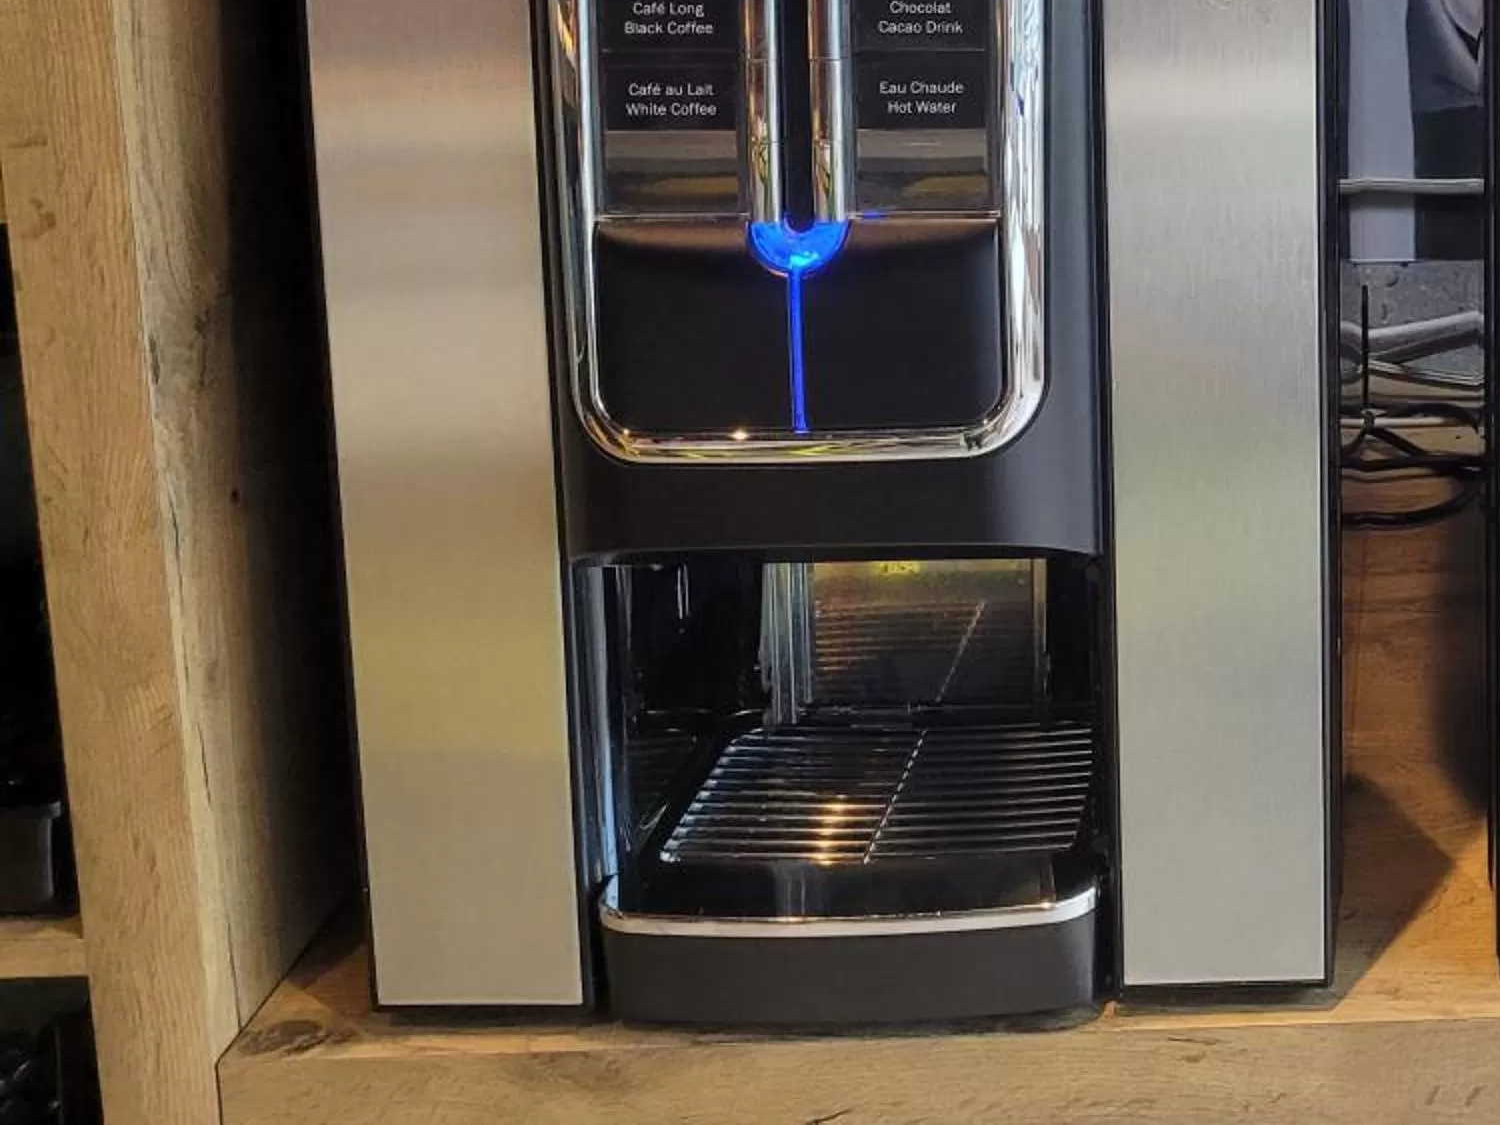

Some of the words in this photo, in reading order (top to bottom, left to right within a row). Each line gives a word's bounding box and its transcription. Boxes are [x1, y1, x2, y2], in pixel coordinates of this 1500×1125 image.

[633, 2, 666, 14] Café
[670, 2, 704, 18] Long
[890, 1, 951, 13] Chocolat
[625, 21, 663, 34] Black
[666, 21, 714, 34] Coffee
[879, 21, 923, 33] Cacao
[927, 20, 963, 33] Drink
[629, 83, 663, 96] Café
[666, 86, 684, 96] au
[688, 83, 713, 96] Lait
[880, 82, 907, 94] Eau
[911, 81, 964, 94] Chaude
[626, 103, 666, 116] White
[671, 103, 716, 116] Coffee
[888, 101, 911, 113] Hot
[915, 101, 956, 113] Water
